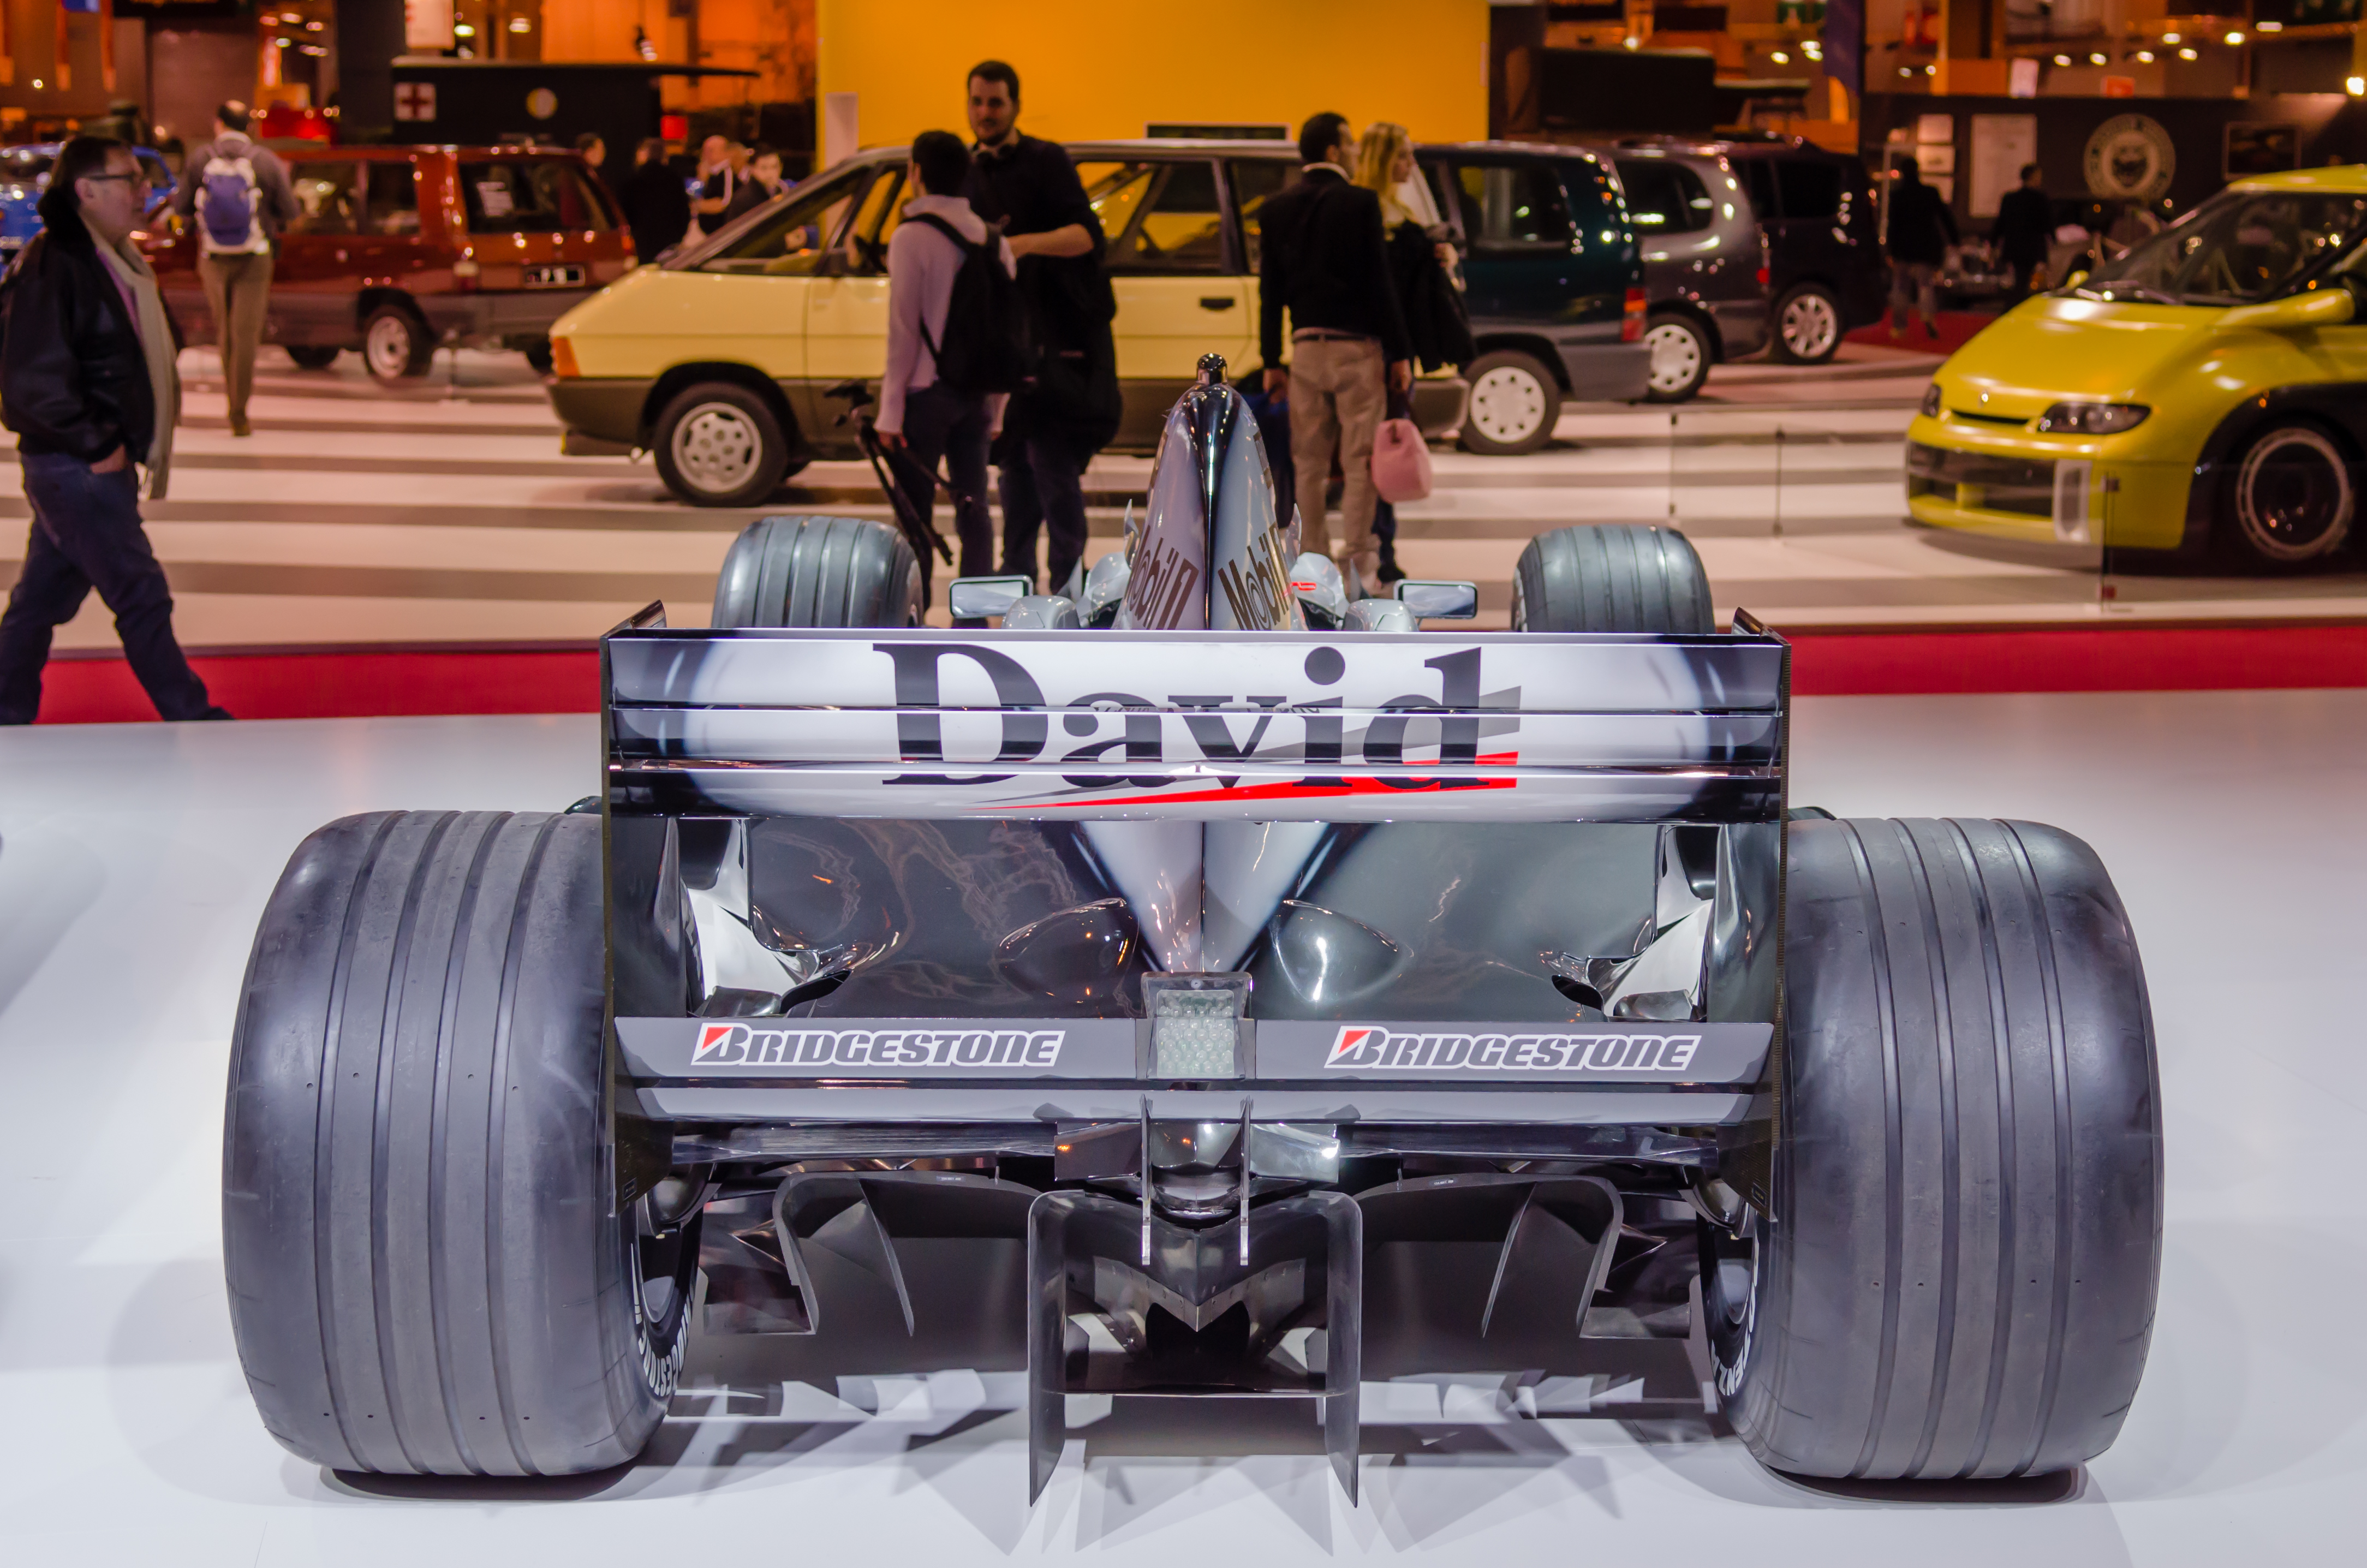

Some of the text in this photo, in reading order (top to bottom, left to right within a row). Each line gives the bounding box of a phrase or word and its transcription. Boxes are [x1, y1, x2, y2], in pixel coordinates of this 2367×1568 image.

[1218, 533, 1290, 630] Mobil
[873, 643, 1491, 789] David
[691, 1023, 1066, 1066] BRIDGESTONE
[1323, 1026, 1702, 1071] BRIDGESTONE
